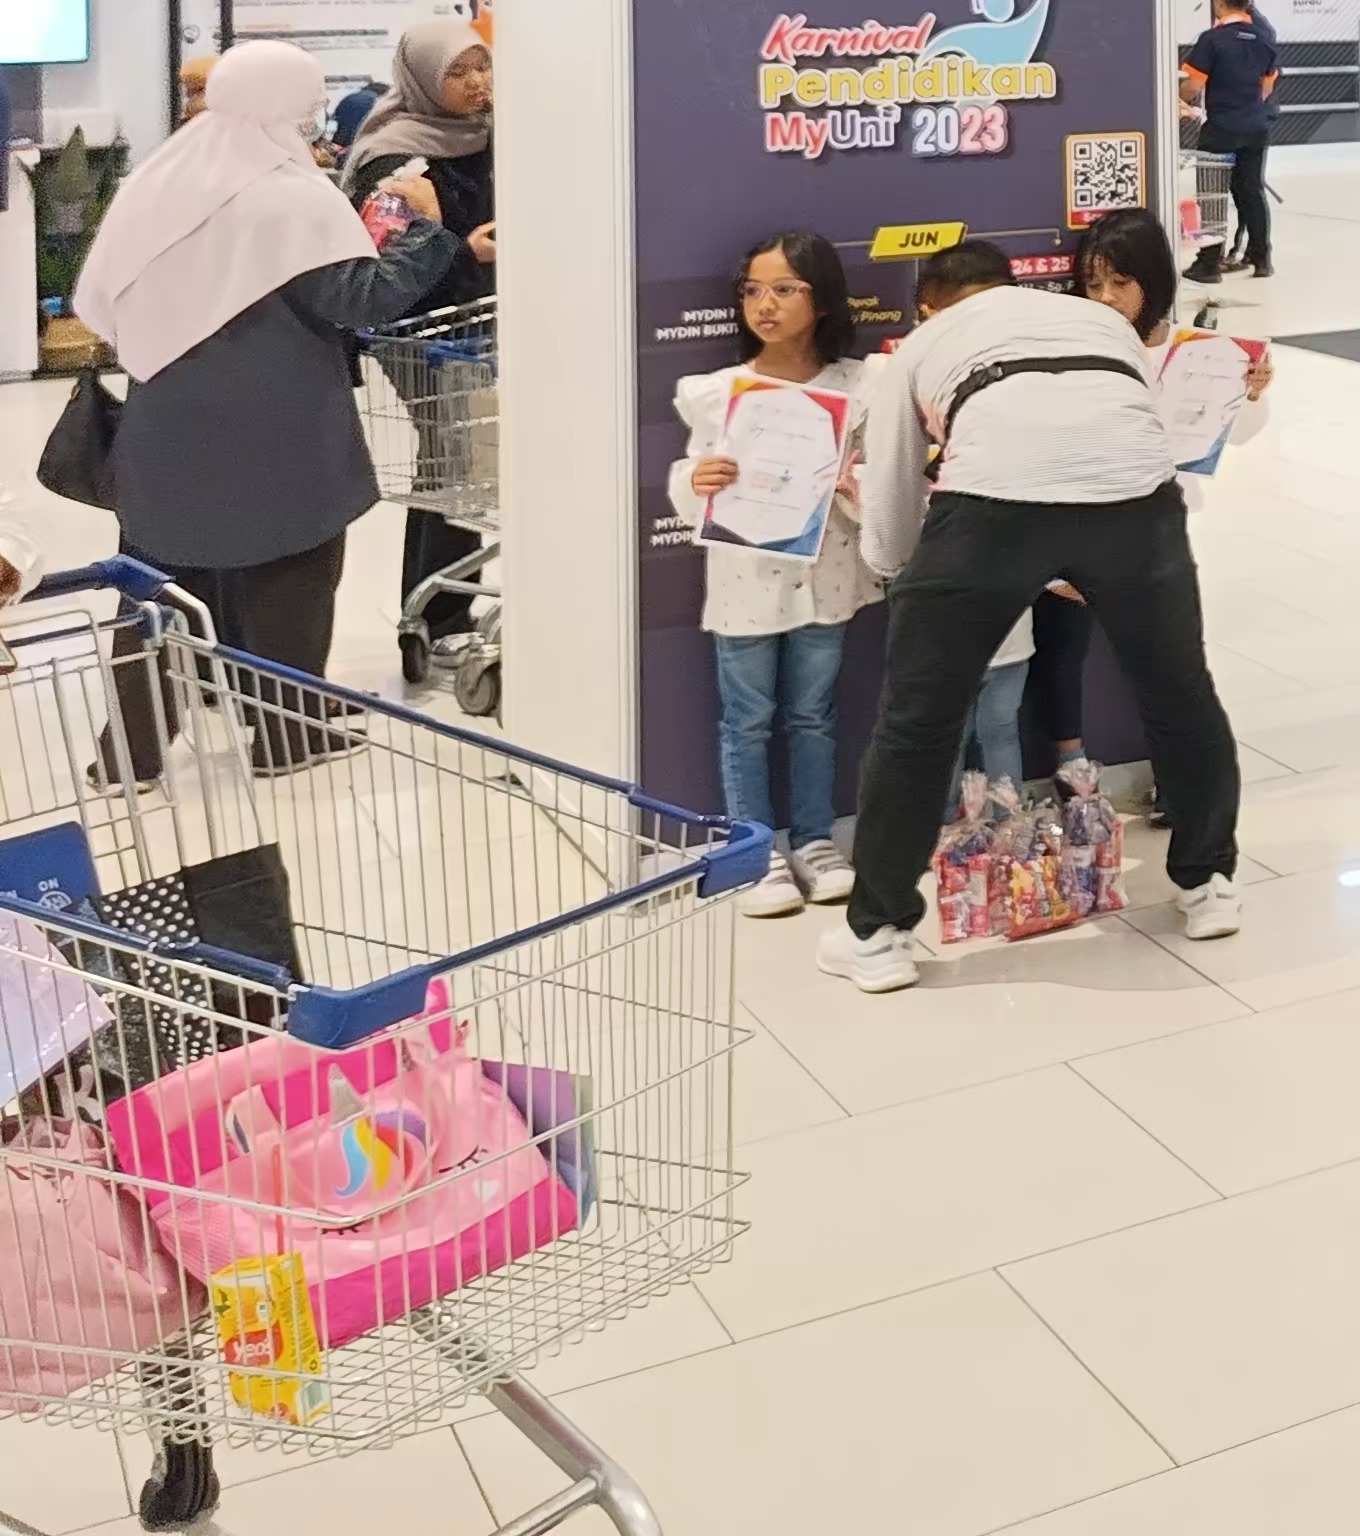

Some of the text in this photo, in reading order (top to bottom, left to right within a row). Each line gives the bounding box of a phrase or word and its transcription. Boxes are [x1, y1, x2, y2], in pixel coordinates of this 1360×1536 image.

[762, 13, 935, 62] Karnival
[760, 60, 1056, 106] Pendidikan
[765, 102, 1009, 156] MyUni 2023
[899, 231, 939, 248] JUN
[1051, 256, 1070, 272] 25
[683, 308, 727, 322] MYDIN
[656, 326, 700, 340] MYDIN
